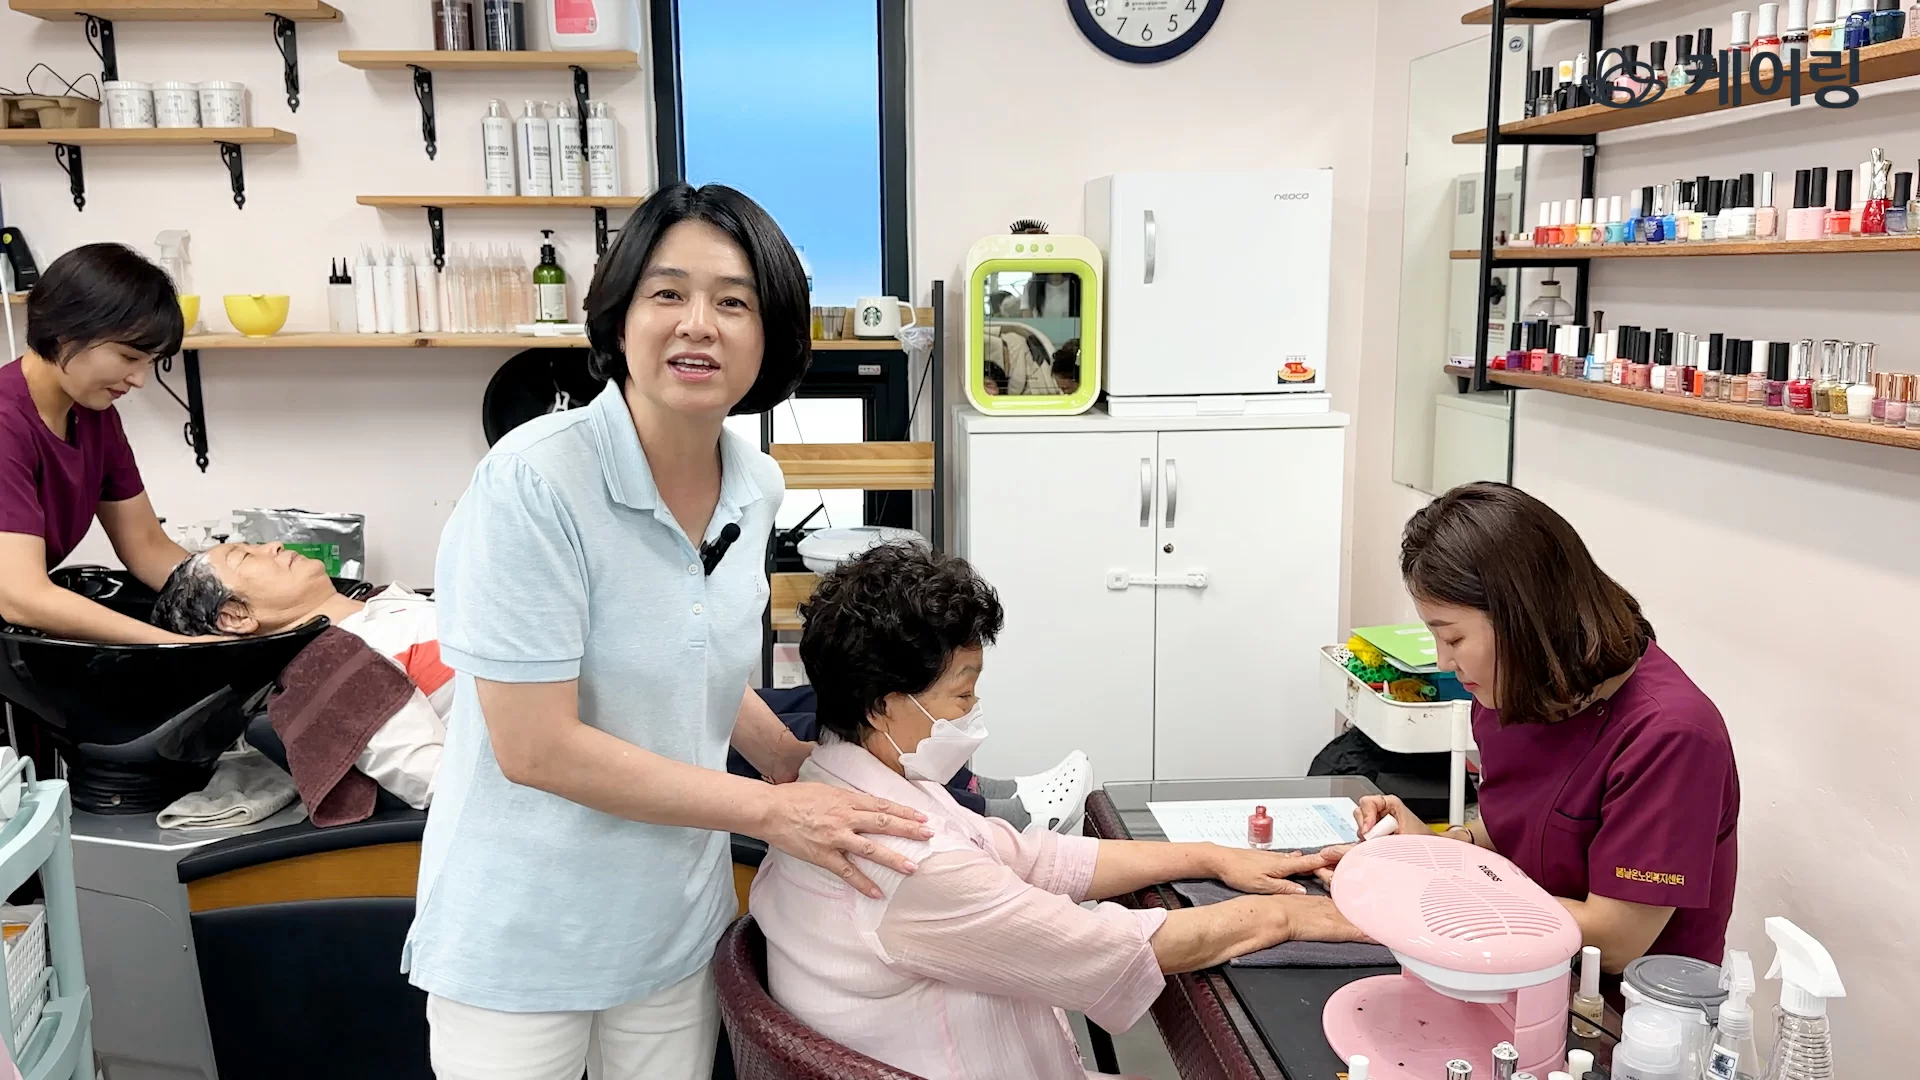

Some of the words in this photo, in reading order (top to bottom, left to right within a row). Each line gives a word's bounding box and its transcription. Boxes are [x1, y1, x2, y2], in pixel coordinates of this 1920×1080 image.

[1095, 0, 1106, 17] 8
[1185, 0, 1197, 13] 4
[1117, 17, 1128, 35] 7
[1167, 14, 1178, 32] 5
[1141, 23, 1153, 42] 6
